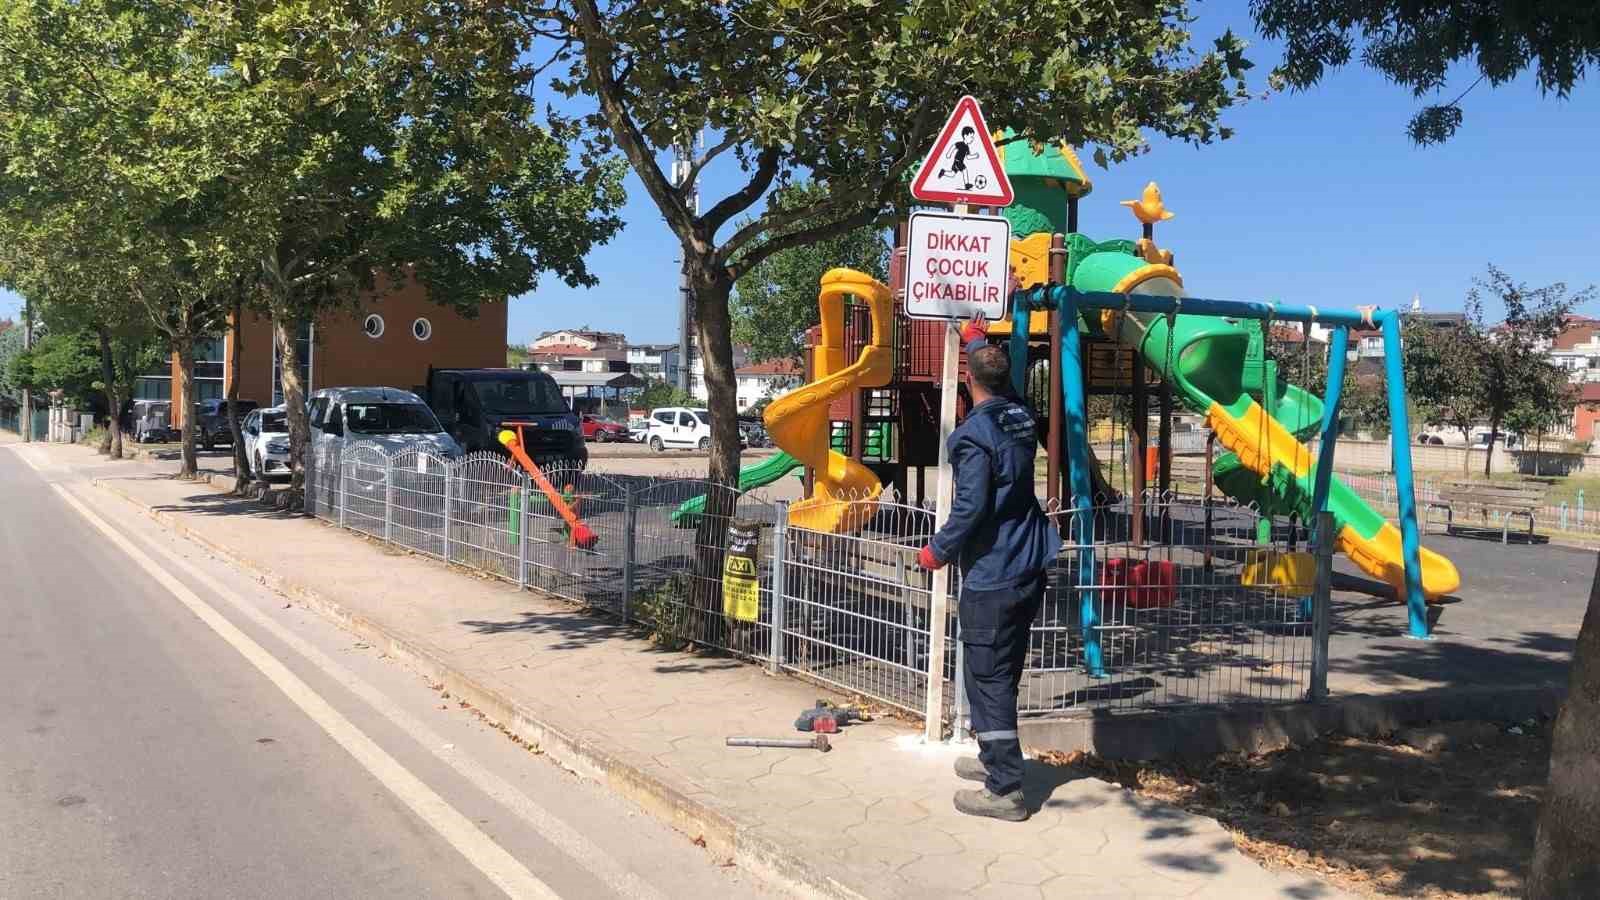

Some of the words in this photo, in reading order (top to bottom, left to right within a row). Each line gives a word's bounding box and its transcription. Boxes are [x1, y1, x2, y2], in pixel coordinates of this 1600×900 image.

[927, 230, 991, 253] DİKKAT
[926, 257, 988, 278] ÇOCUK
[912, 281, 999, 303] ÇIKABİLİR
